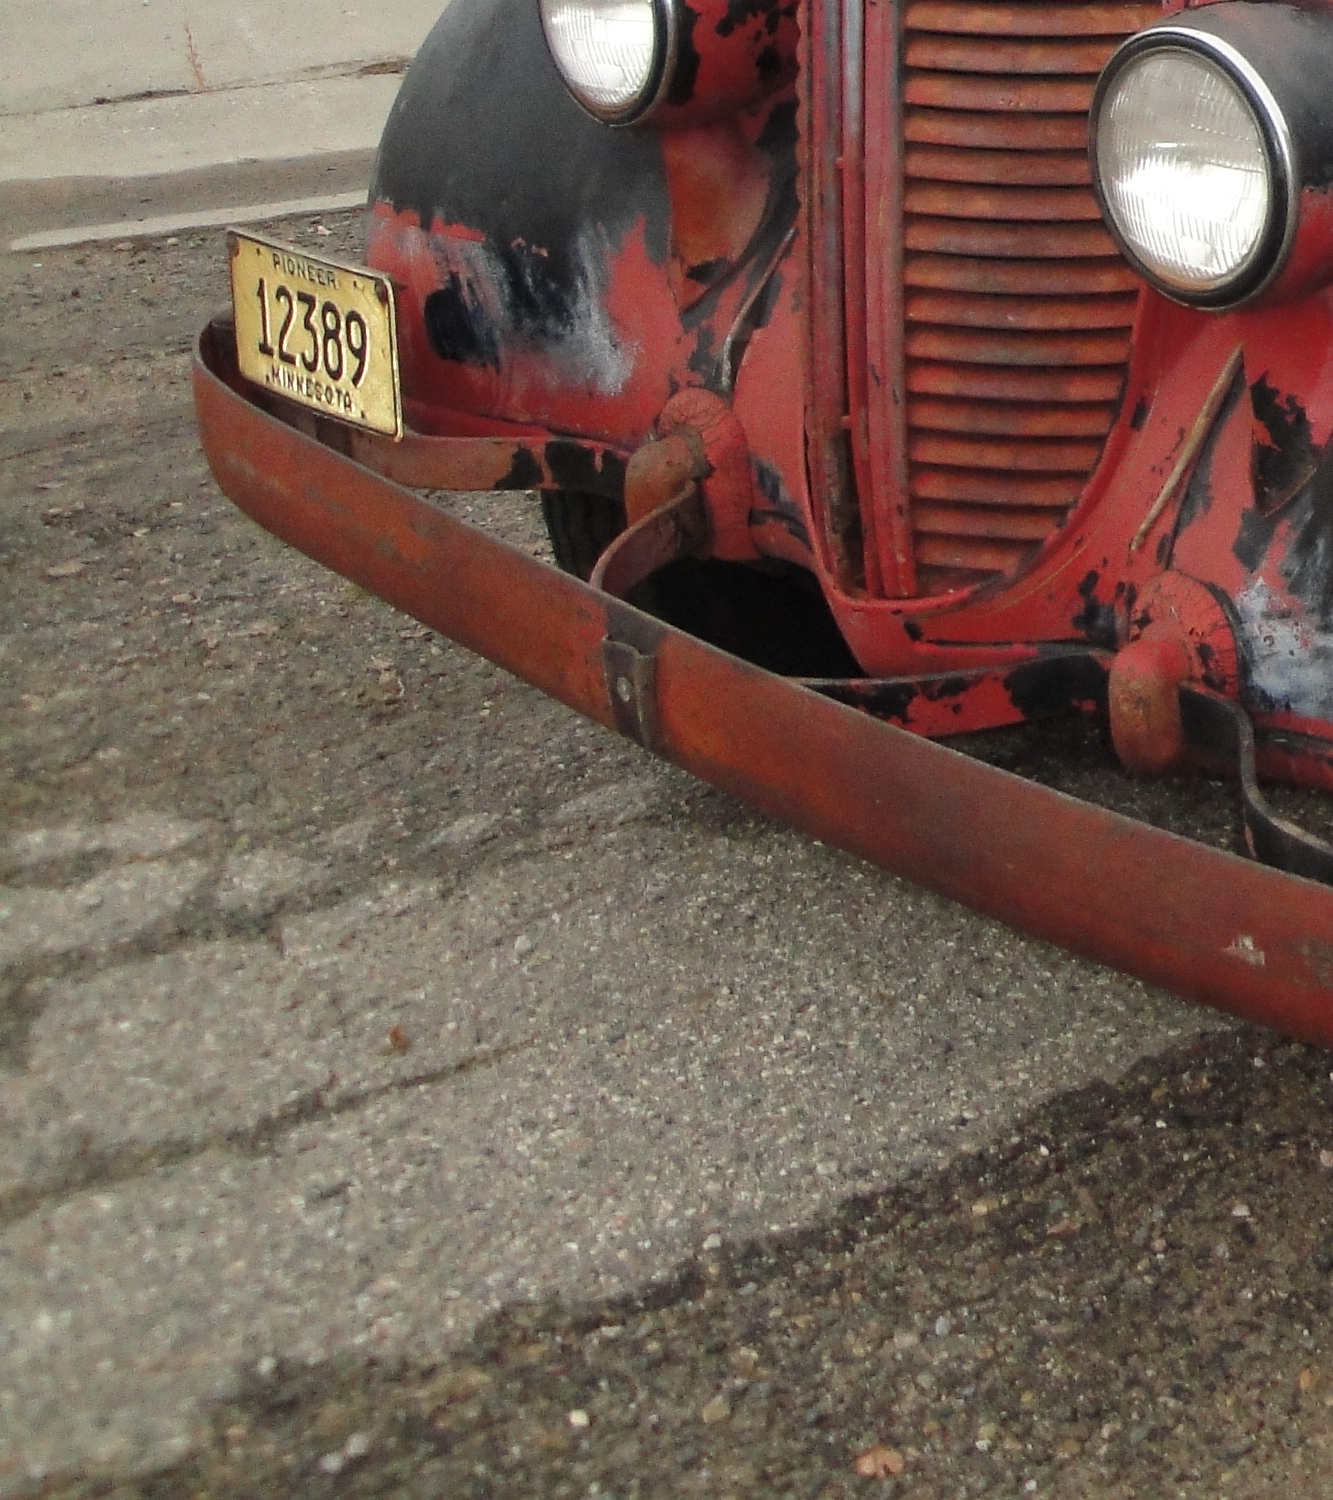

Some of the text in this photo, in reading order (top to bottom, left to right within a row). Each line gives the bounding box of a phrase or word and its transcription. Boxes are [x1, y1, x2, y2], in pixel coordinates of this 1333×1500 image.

[272, 254, 336, 288] PIONEER
[256, 277, 368, 388] 12389
[271, 365, 352, 412] MINNESOTA
